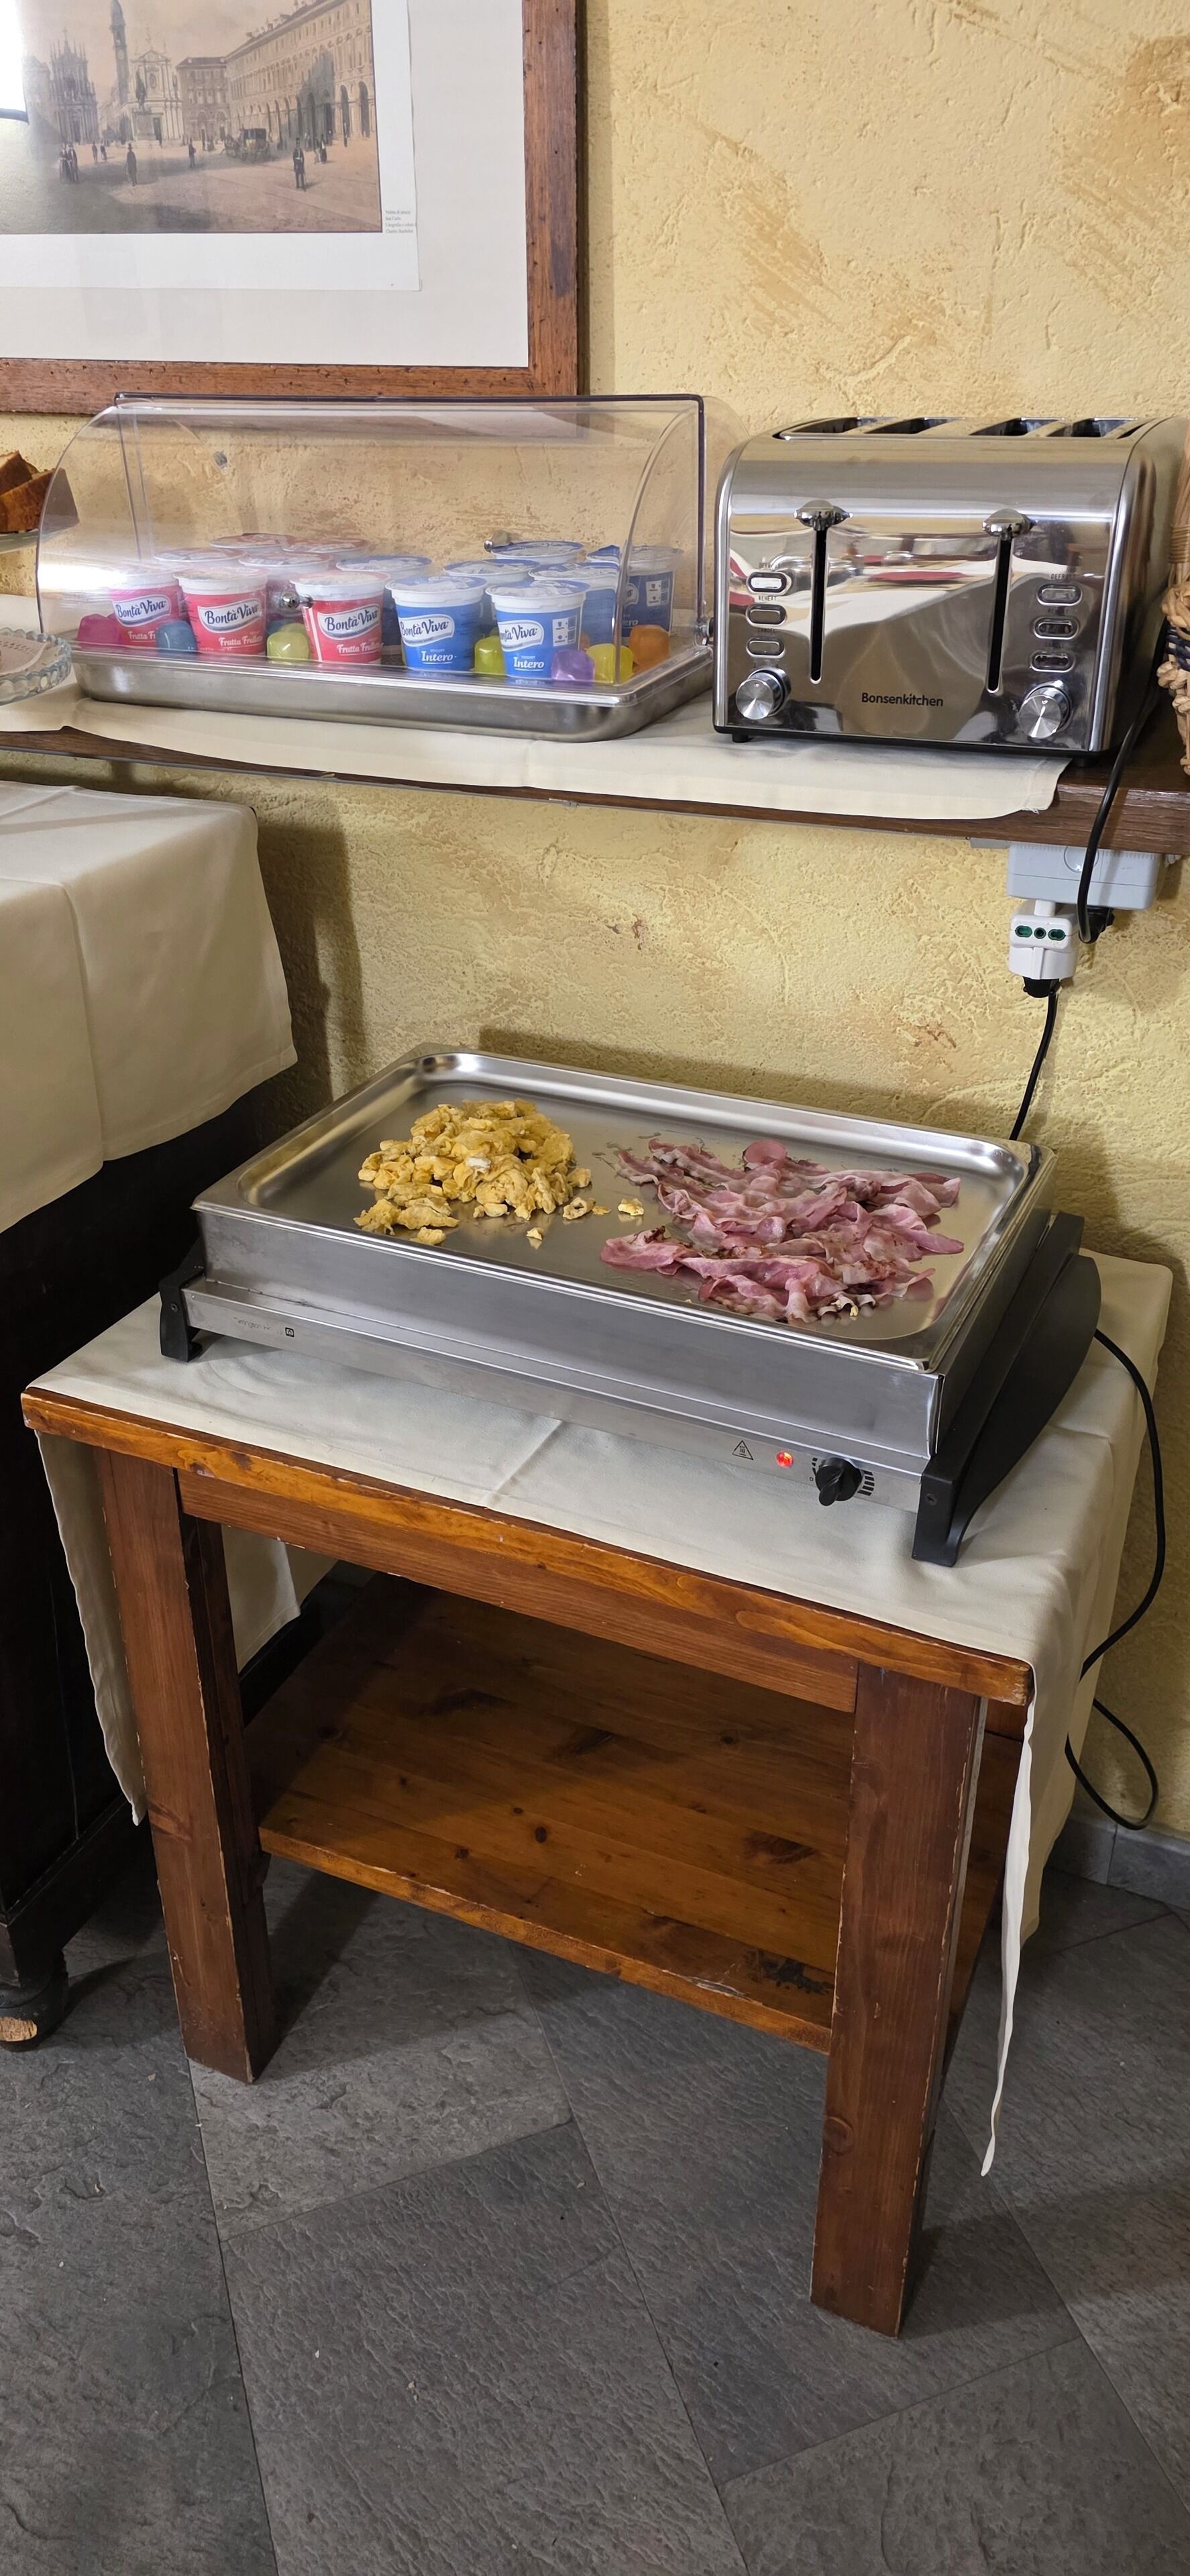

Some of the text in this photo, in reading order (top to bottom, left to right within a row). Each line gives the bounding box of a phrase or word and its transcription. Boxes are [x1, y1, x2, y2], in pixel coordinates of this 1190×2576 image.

[115, 599, 165, 618] Bontà Viva
[205, 604, 259, 625] Bontà Viva
[325, 609, 379, 631] Bontà Viva
[400, 619, 448, 637] Bontà Viva
[512, 625, 536, 641] Viva
[219, 637, 241, 646] Frutta
[337, 644, 360, 653] Frutta
[421, 651, 453, 661] Intero
[513, 657, 545, 669] Intero
[861, 692, 943, 706] Bonsenkitchen
